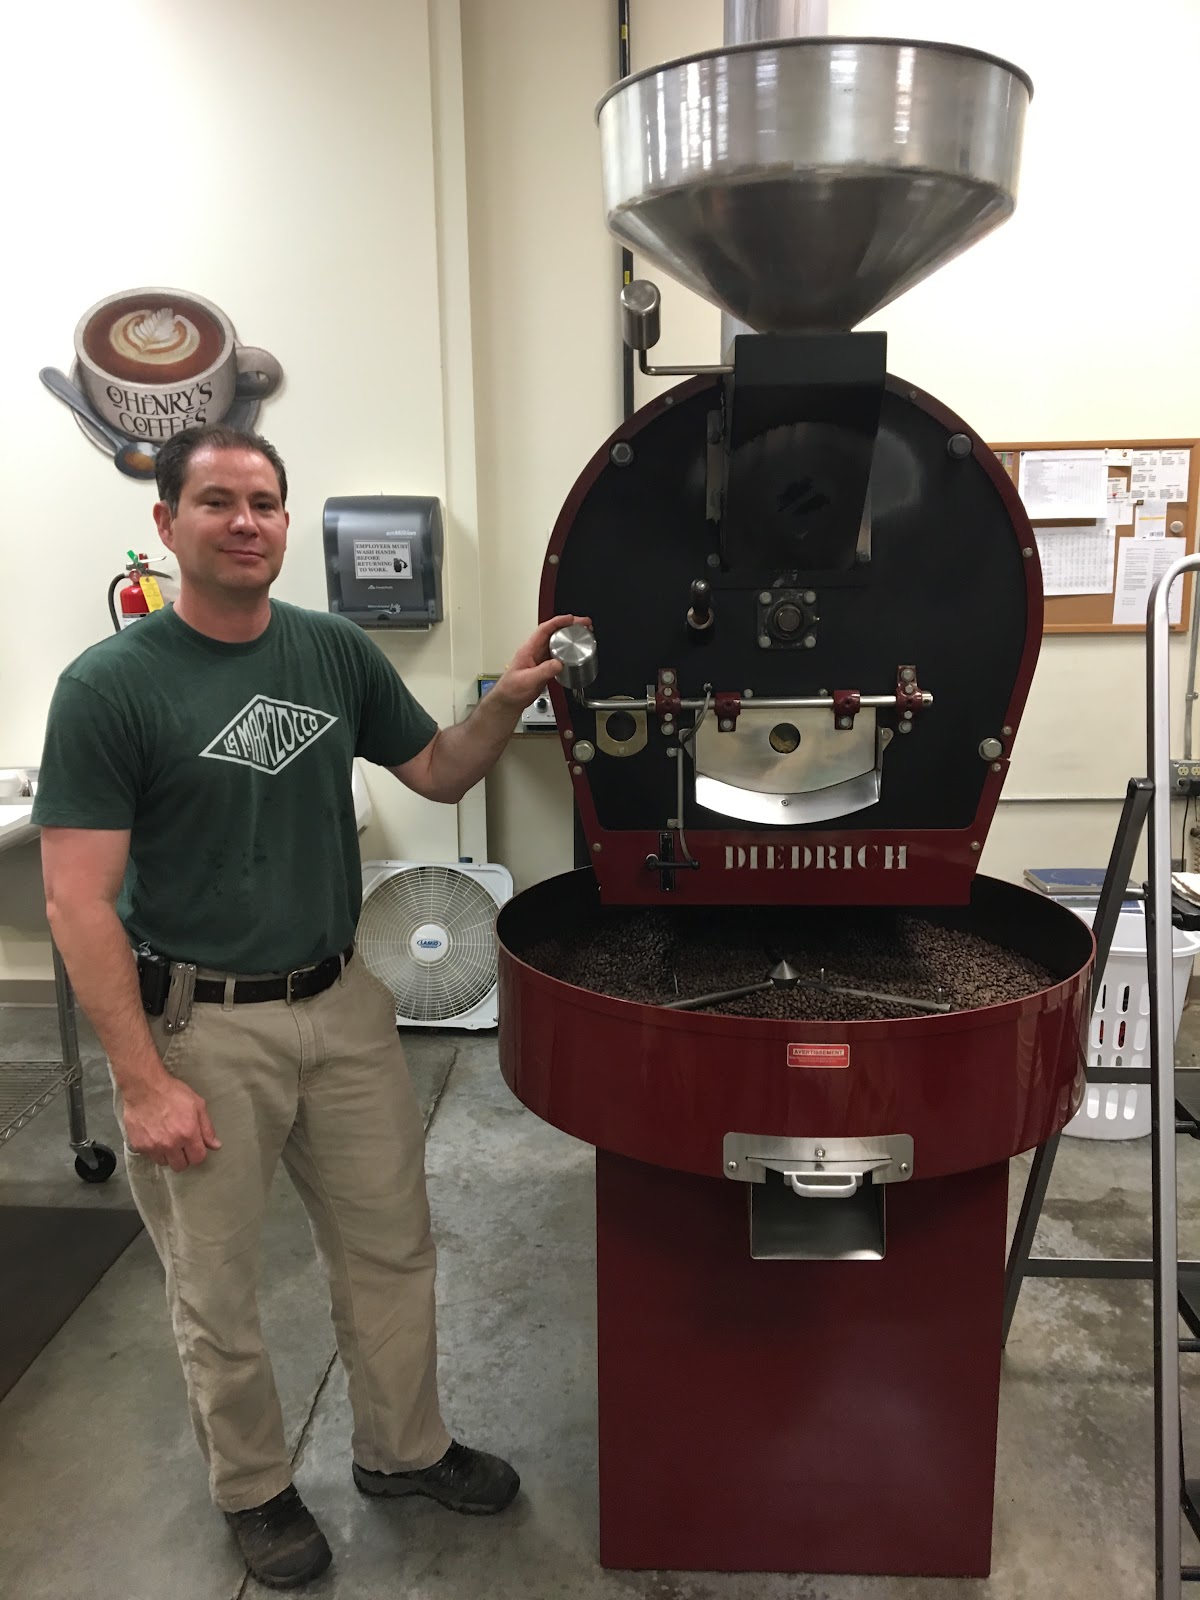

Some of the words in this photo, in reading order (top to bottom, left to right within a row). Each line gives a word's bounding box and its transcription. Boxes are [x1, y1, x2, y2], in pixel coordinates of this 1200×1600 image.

[223, 730, 241, 757] LA
[236, 701, 318, 767] MARZOCCO
[724, 845, 908, 870] DIEDRICH
